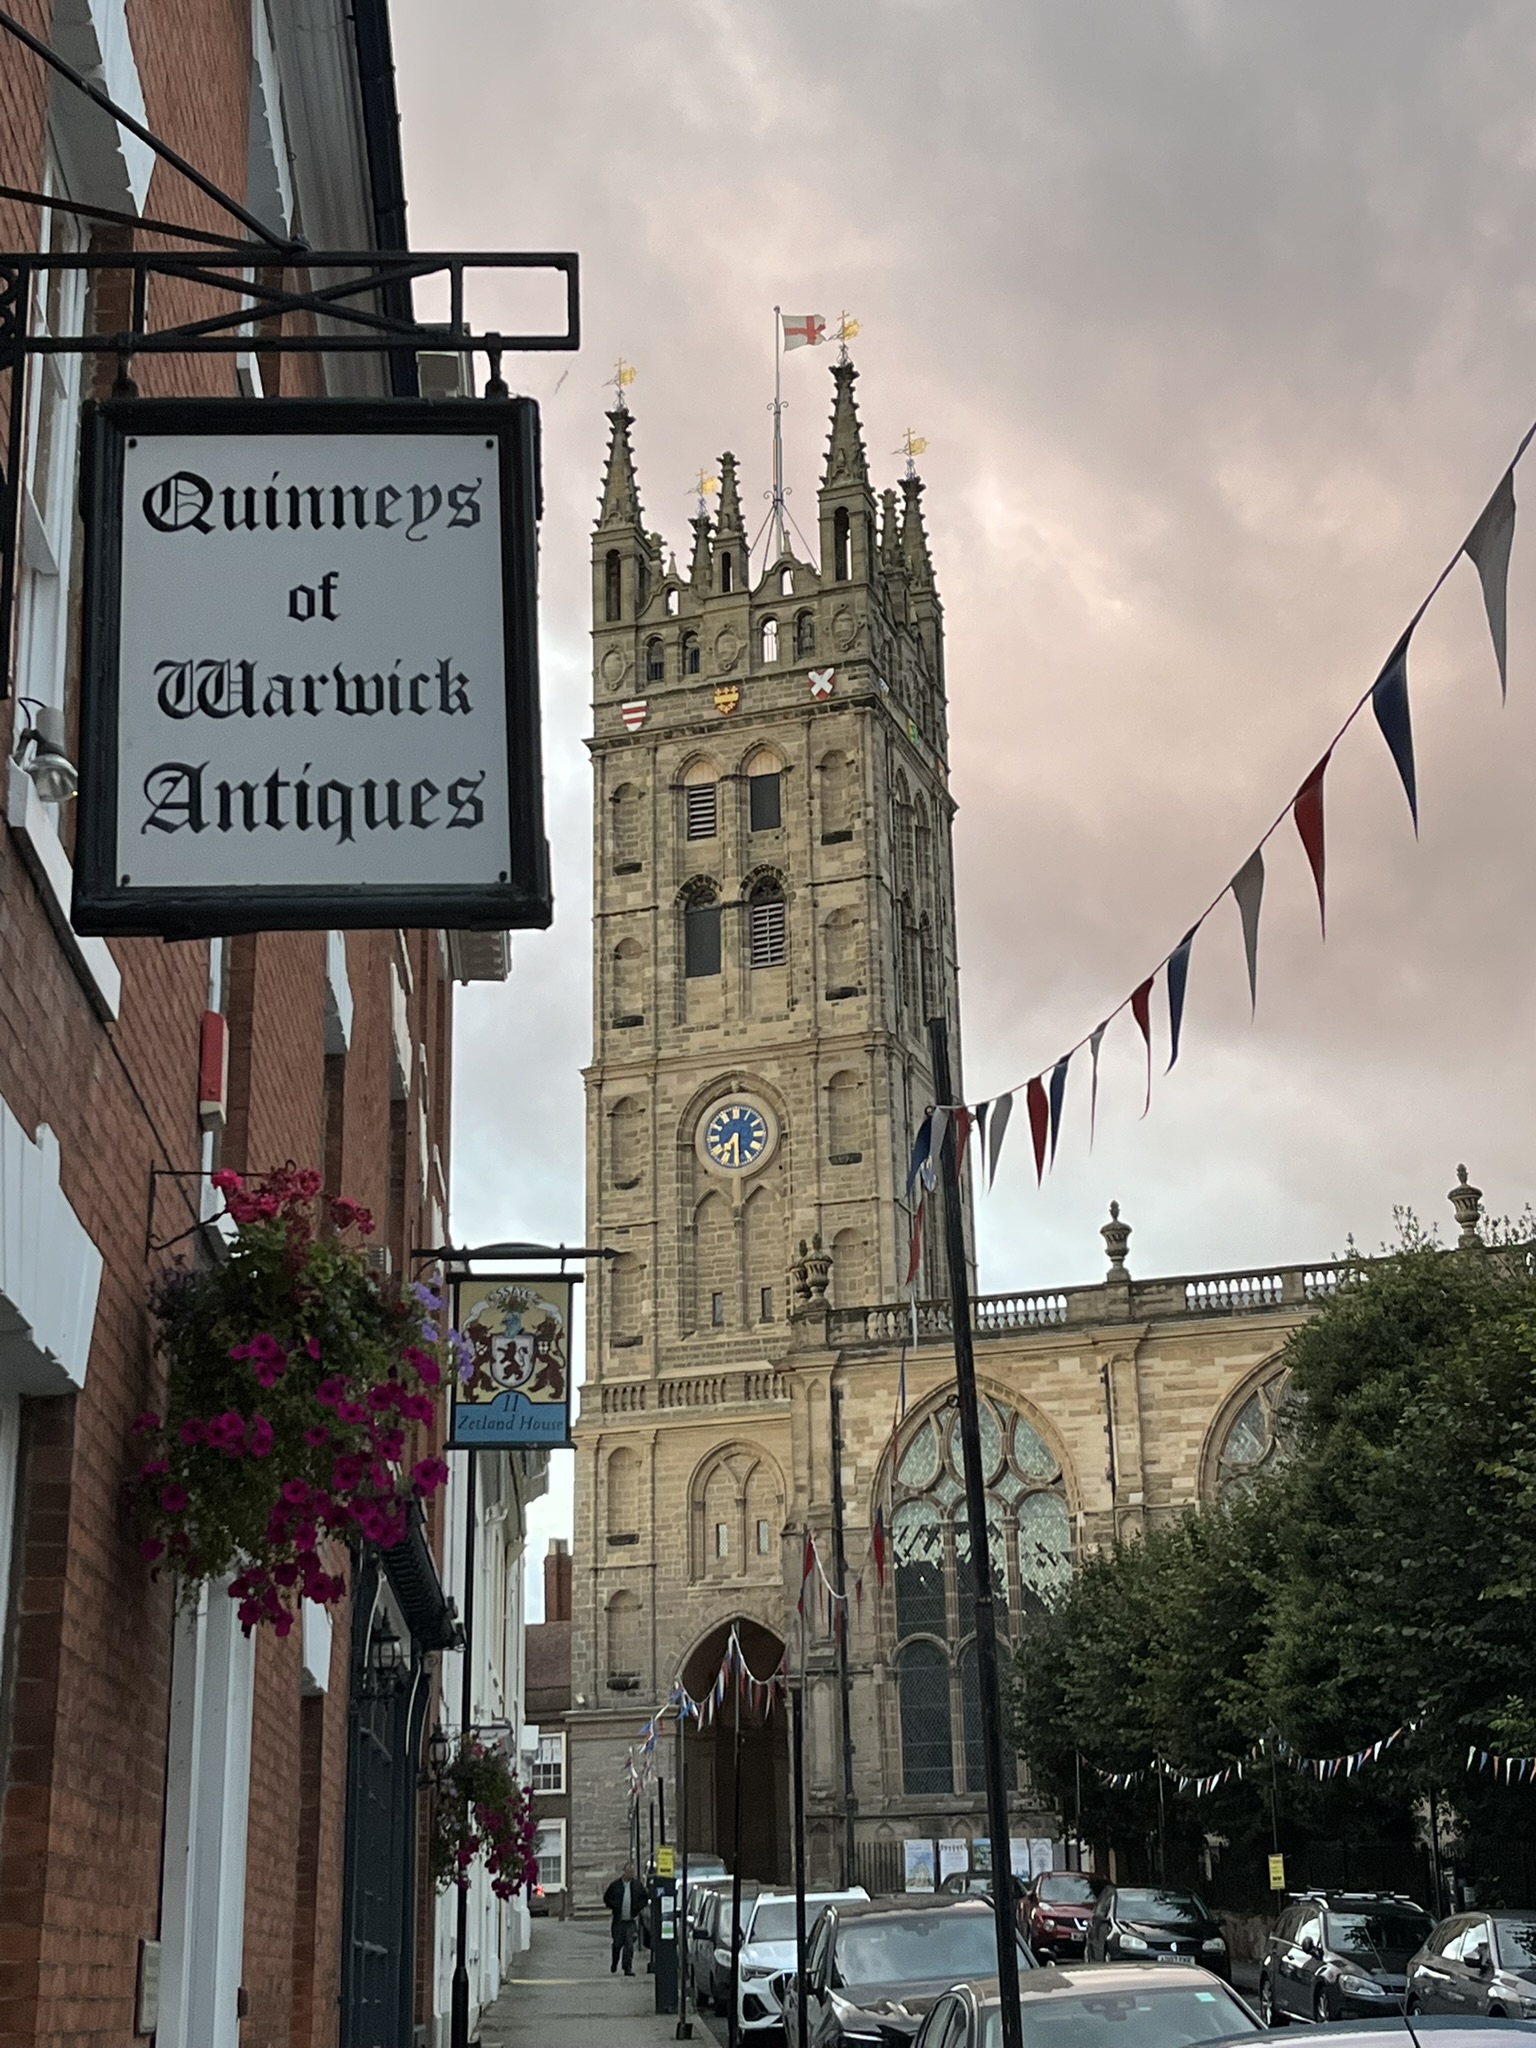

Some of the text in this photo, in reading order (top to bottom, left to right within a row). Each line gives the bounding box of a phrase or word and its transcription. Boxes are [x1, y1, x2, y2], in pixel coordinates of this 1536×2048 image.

[142, 471, 482, 542] Quinneys
[288, 571, 340, 622] of
[153, 657, 473, 719] Warwick
[141, 761, 486, 845] Antiques
[458, 1414, 563, 1431] Zetland House
